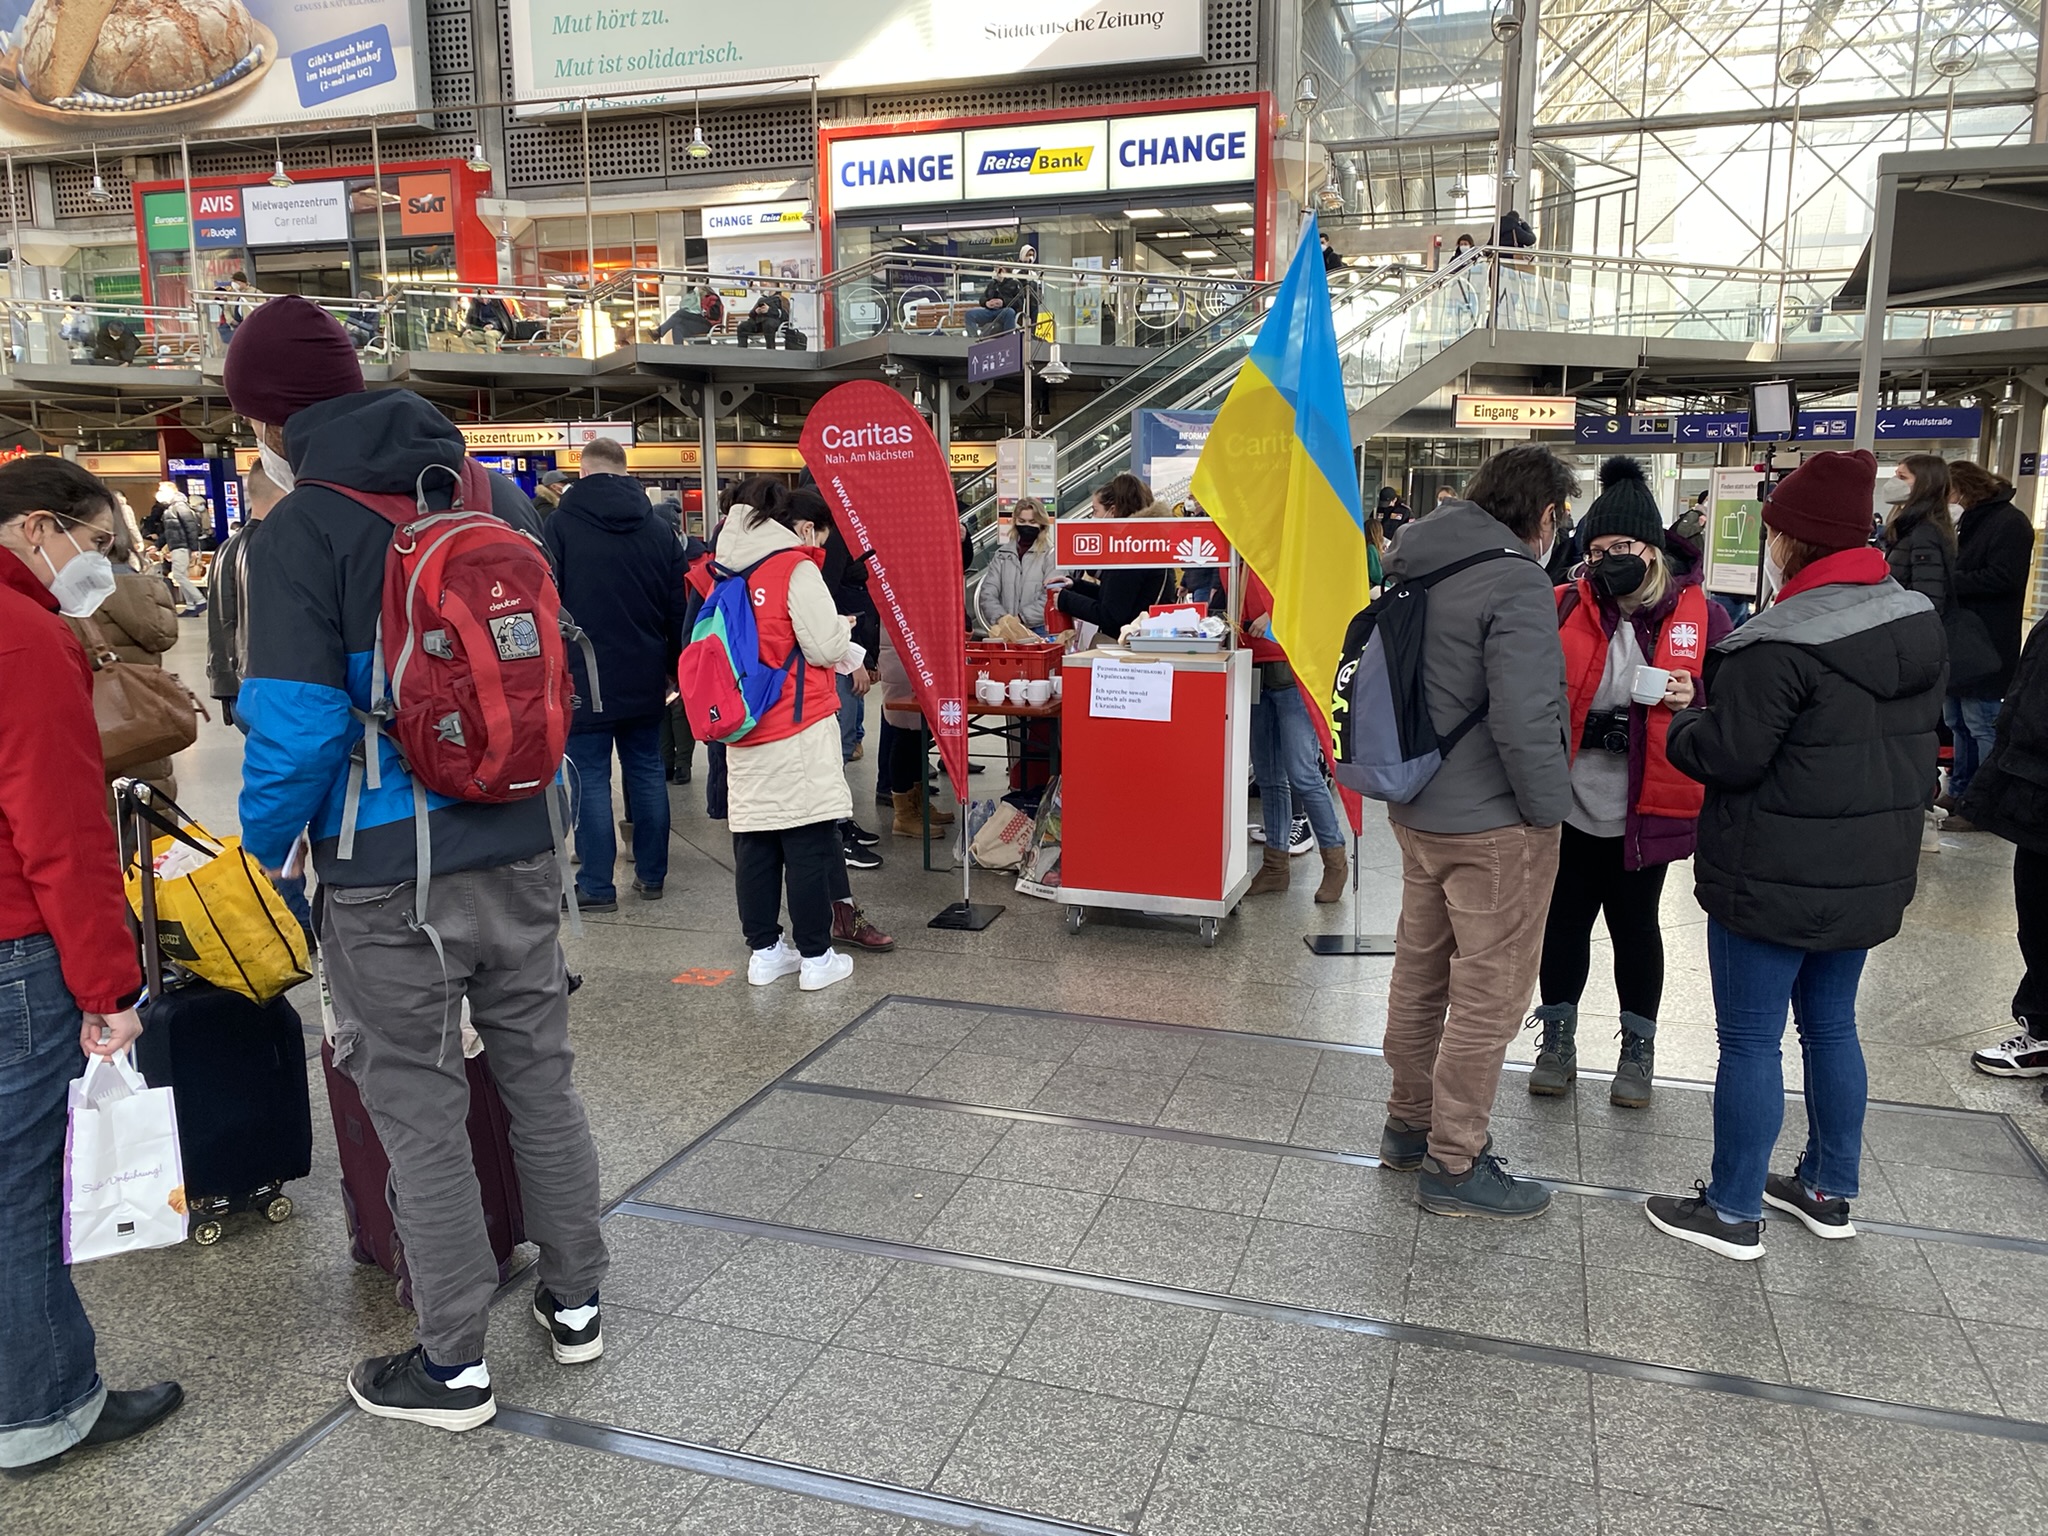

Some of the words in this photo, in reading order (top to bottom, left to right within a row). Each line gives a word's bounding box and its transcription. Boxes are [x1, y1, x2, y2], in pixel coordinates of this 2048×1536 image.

[552, 14, 592, 35] Mut
[596, 9, 638, 31] hört
[642, 9, 669, 26] zu.
[1096, 11, 1164, 30] Zeitung
[307, 51, 333, 68] Gibt's
[334, 44, 355, 59] auch
[356, 40, 374, 52] hier
[554, 56, 594, 78] Mut
[598, 54, 623, 74] ist
[627, 41, 743, 71] solidarisch.
[306, 71, 317, 82] im
[319, 47, 382, 78] Hauptbahnhof
[320, 75, 345, 92] (2-mal
[346, 73, 356, 82] im
[357, 66, 372, 79] UG)
[1119, 131, 1247, 168] CHANGE
[841, 153, 954, 188] CHANGE
[199, 195, 234, 214] AVIS
[252, 196, 339, 212] Mietwagenzentrum
[154, 215, 185, 225] Europcar
[274, 216, 290, 227] Car
[291, 215, 318, 226] rental
[709, 215, 753, 228] CHANGE
[210, 227, 237, 239] Budget
[1474, 404, 1519, 420] Eingang
[1903, 418, 1953, 426] Arnulfstraße
[464, 431, 535, 443] eisezentrum
[822, 422, 913, 449] Caritas
[825, 453, 849, 464] Nah.
[850, 452, 866, 462] Am
[868, 450, 914, 461] Nächsten
[950, 453, 980, 464] ngang
[1077, 537, 1098, 551] DB
[831, 475, 934, 688] www.caritasnah-am-naechsten.de
[489, 597, 521, 612] deuter
